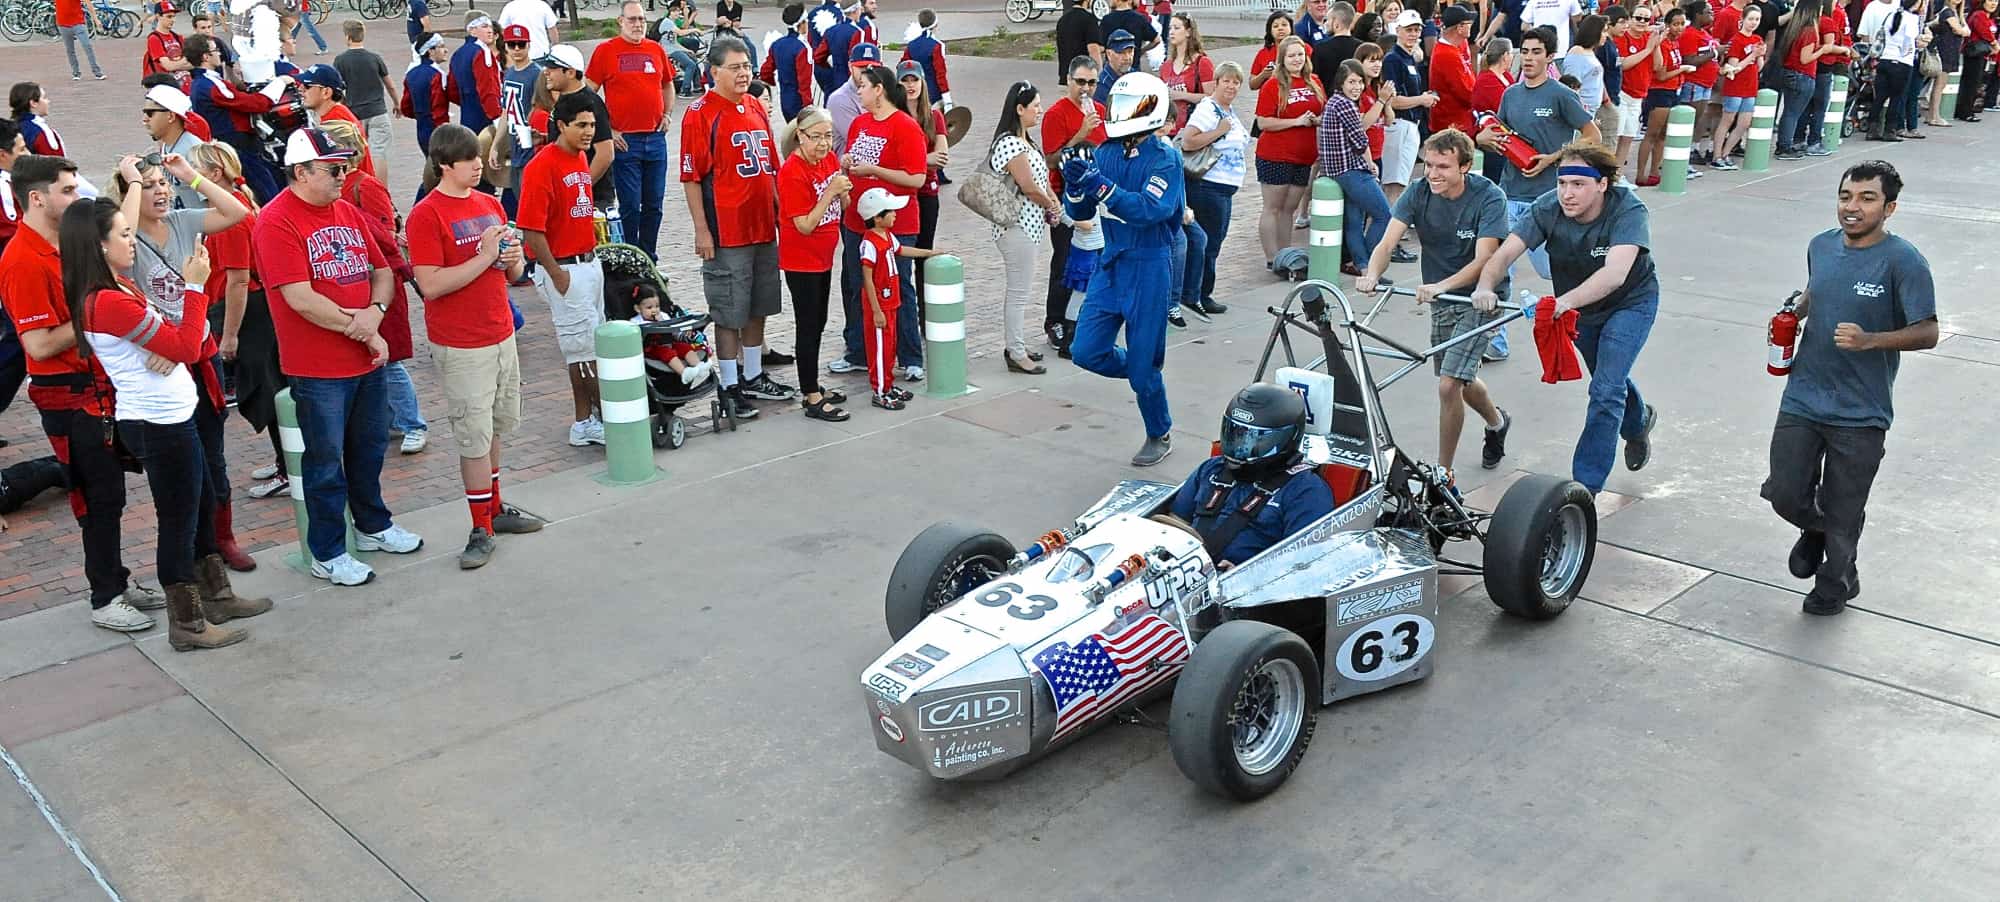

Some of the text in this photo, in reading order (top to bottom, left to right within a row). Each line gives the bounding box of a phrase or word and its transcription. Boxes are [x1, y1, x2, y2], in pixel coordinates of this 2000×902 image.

[731, 130, 773, 177] 35
[306, 226, 367, 263] ARIZONA
[1330, 446, 1372, 462] SKF
[1311, 526, 1328, 544] OF
[1329, 494, 1381, 532] ARIZONA
[1144, 555, 1207, 609] UPR
[975, 582, 1058, 620] 63
[1350, 620, 1420, 673] 63
[869, 673, 907, 698] UPR
[928, 696, 1011, 725] CAID
[945, 752, 977, 769] painting
